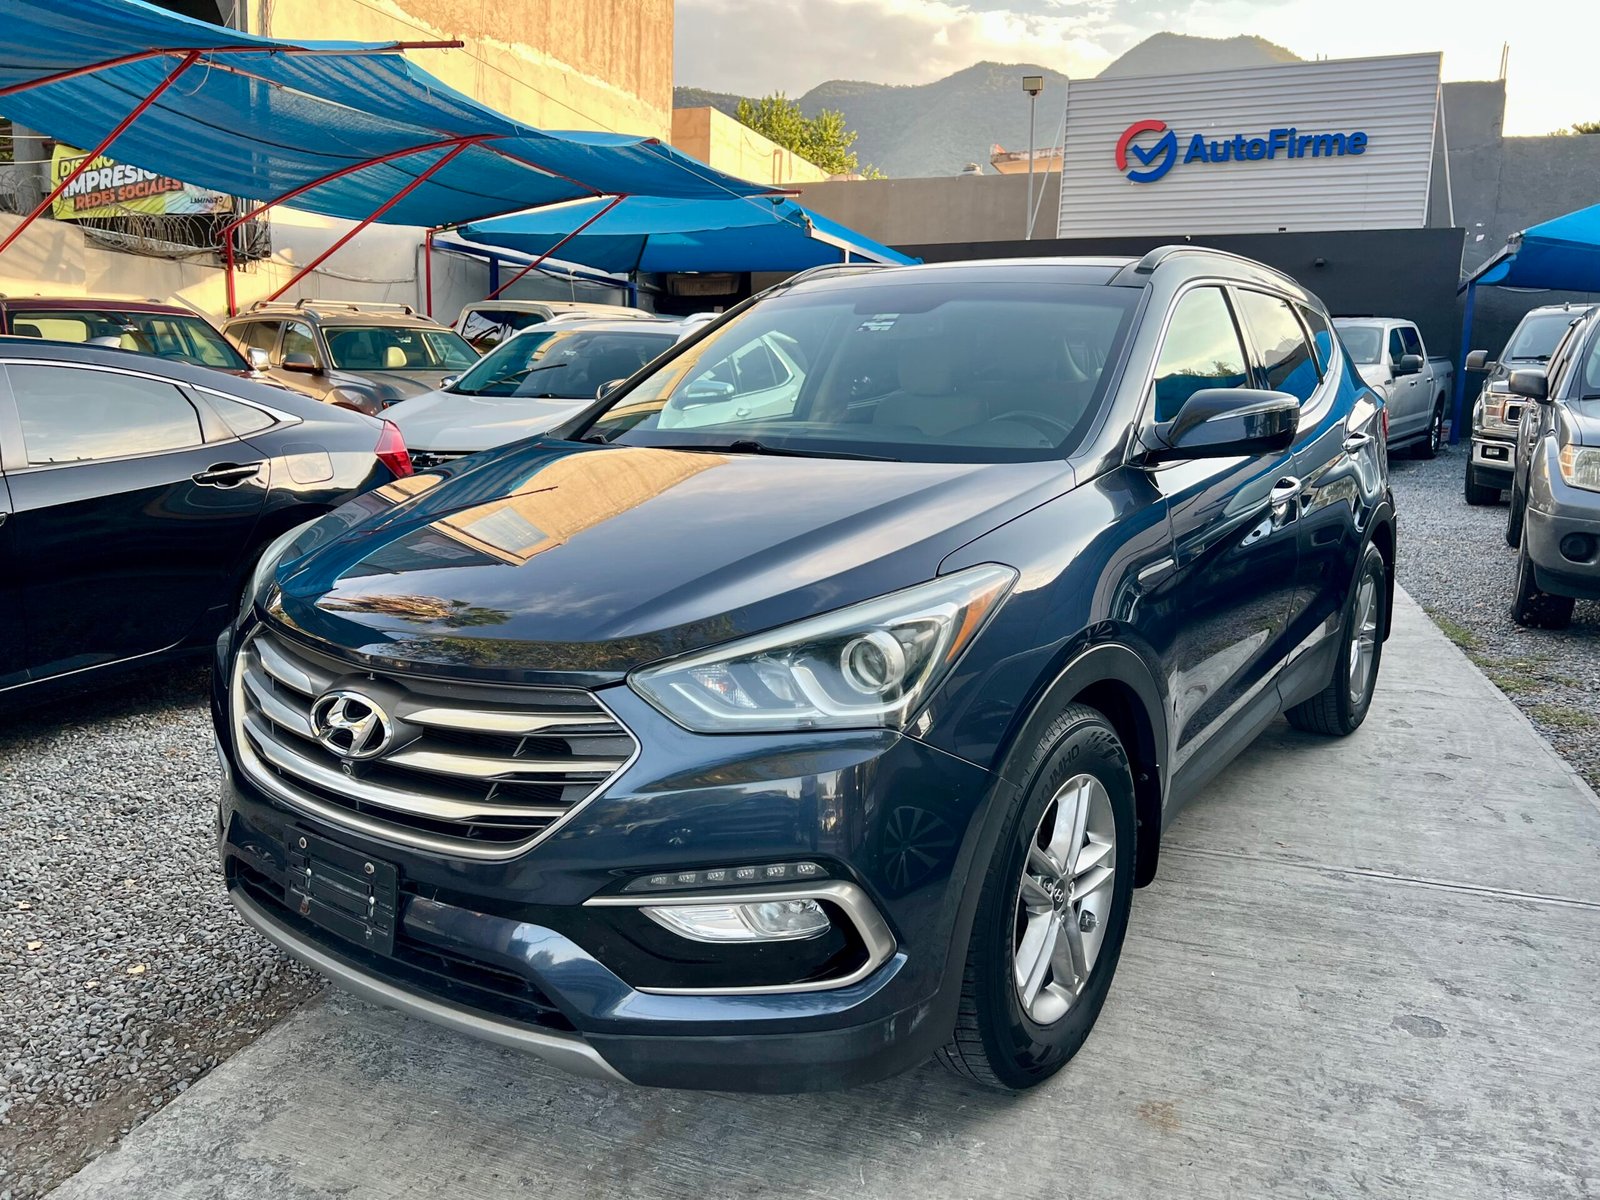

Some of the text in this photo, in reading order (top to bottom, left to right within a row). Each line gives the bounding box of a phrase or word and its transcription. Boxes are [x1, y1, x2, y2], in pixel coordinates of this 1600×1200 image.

[1183, 127, 1368, 164] AutoFirme
[76, 176, 182, 209] REDES SOCIALES
